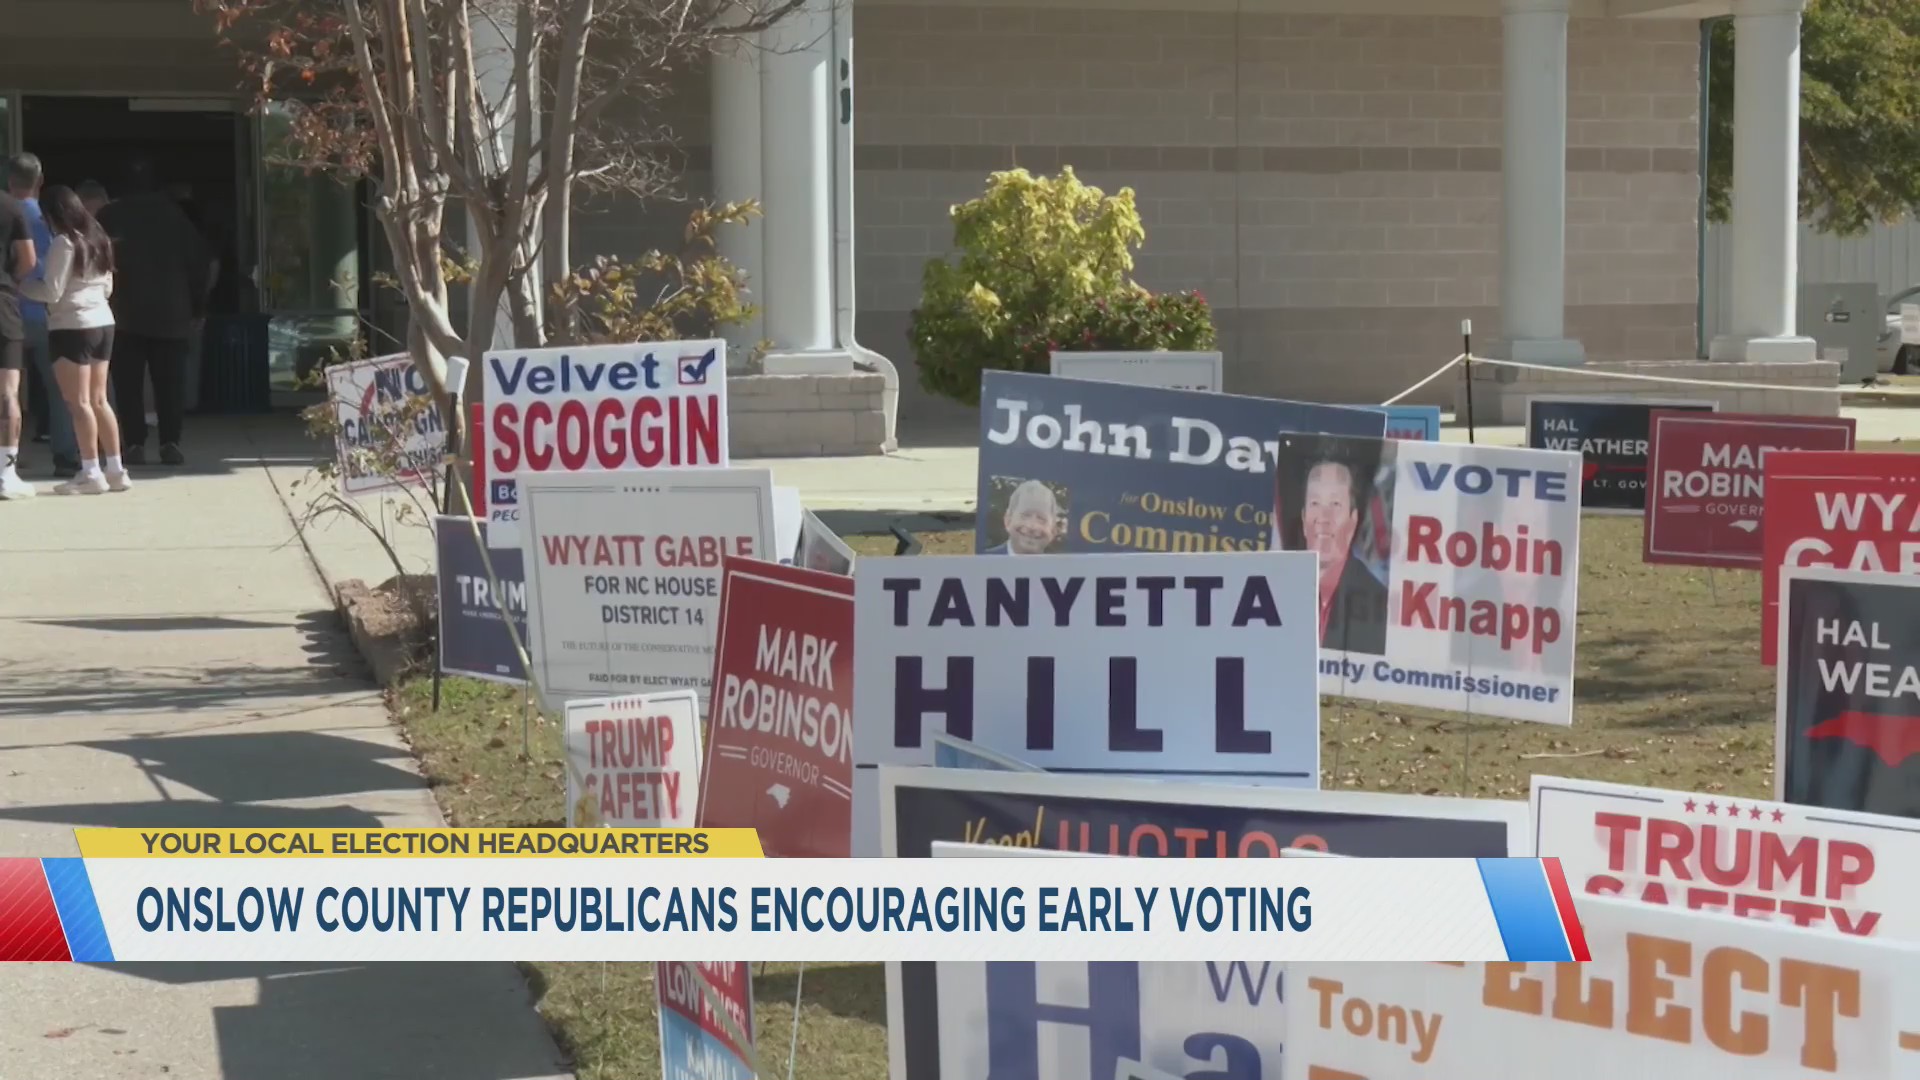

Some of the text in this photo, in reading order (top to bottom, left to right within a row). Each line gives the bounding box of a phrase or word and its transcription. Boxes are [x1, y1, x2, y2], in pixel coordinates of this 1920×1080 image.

[490, 352, 661, 396] Velvet
[493, 394, 720, 474] SCOGGIN
[987, 398, 1152, 459] John
[1544, 419, 1579, 433] HAL
[1544, 437, 1648, 456] WEATHER
[1702, 443, 1802, 469] MA
[1413, 461, 1567, 503] VOTE
[1593, 480, 1611, 489] LT.
[1121, 491, 1139, 504] for
[1140, 492, 1227, 521] Onslow
[542, 535, 645, 567] WYATT
[1406, 514, 1563, 577] Robin
[585, 575, 718, 597] FOR NC HOUSE
[883, 575, 1283, 628] TANYETTA
[602, 605, 704, 626] DISTRICT 14
[1400, 579, 1561, 655] Knapp
[1816, 617, 1891, 650] HAL
[755, 624, 838, 691] MARK
[589, 673, 609, 683] PAID
[610, 674, 628, 684] FOR
[630, 674, 641, 684] BY
[643, 675, 668, 686] ELECT
[670, 676, 699, 687] WYATT
[1373, 661, 1560, 703] Commissioner
[721, 673, 853, 764] ROBINSON
[894, 656, 1272, 754] HILL
[585, 715, 675, 769] TRUMP
[751, 746, 820, 787] GOVERNOR
[1595, 811, 1875, 901] TRUMP
[665, 961, 699, 1015] LOW
[1308, 976, 1443, 1064] Tony
